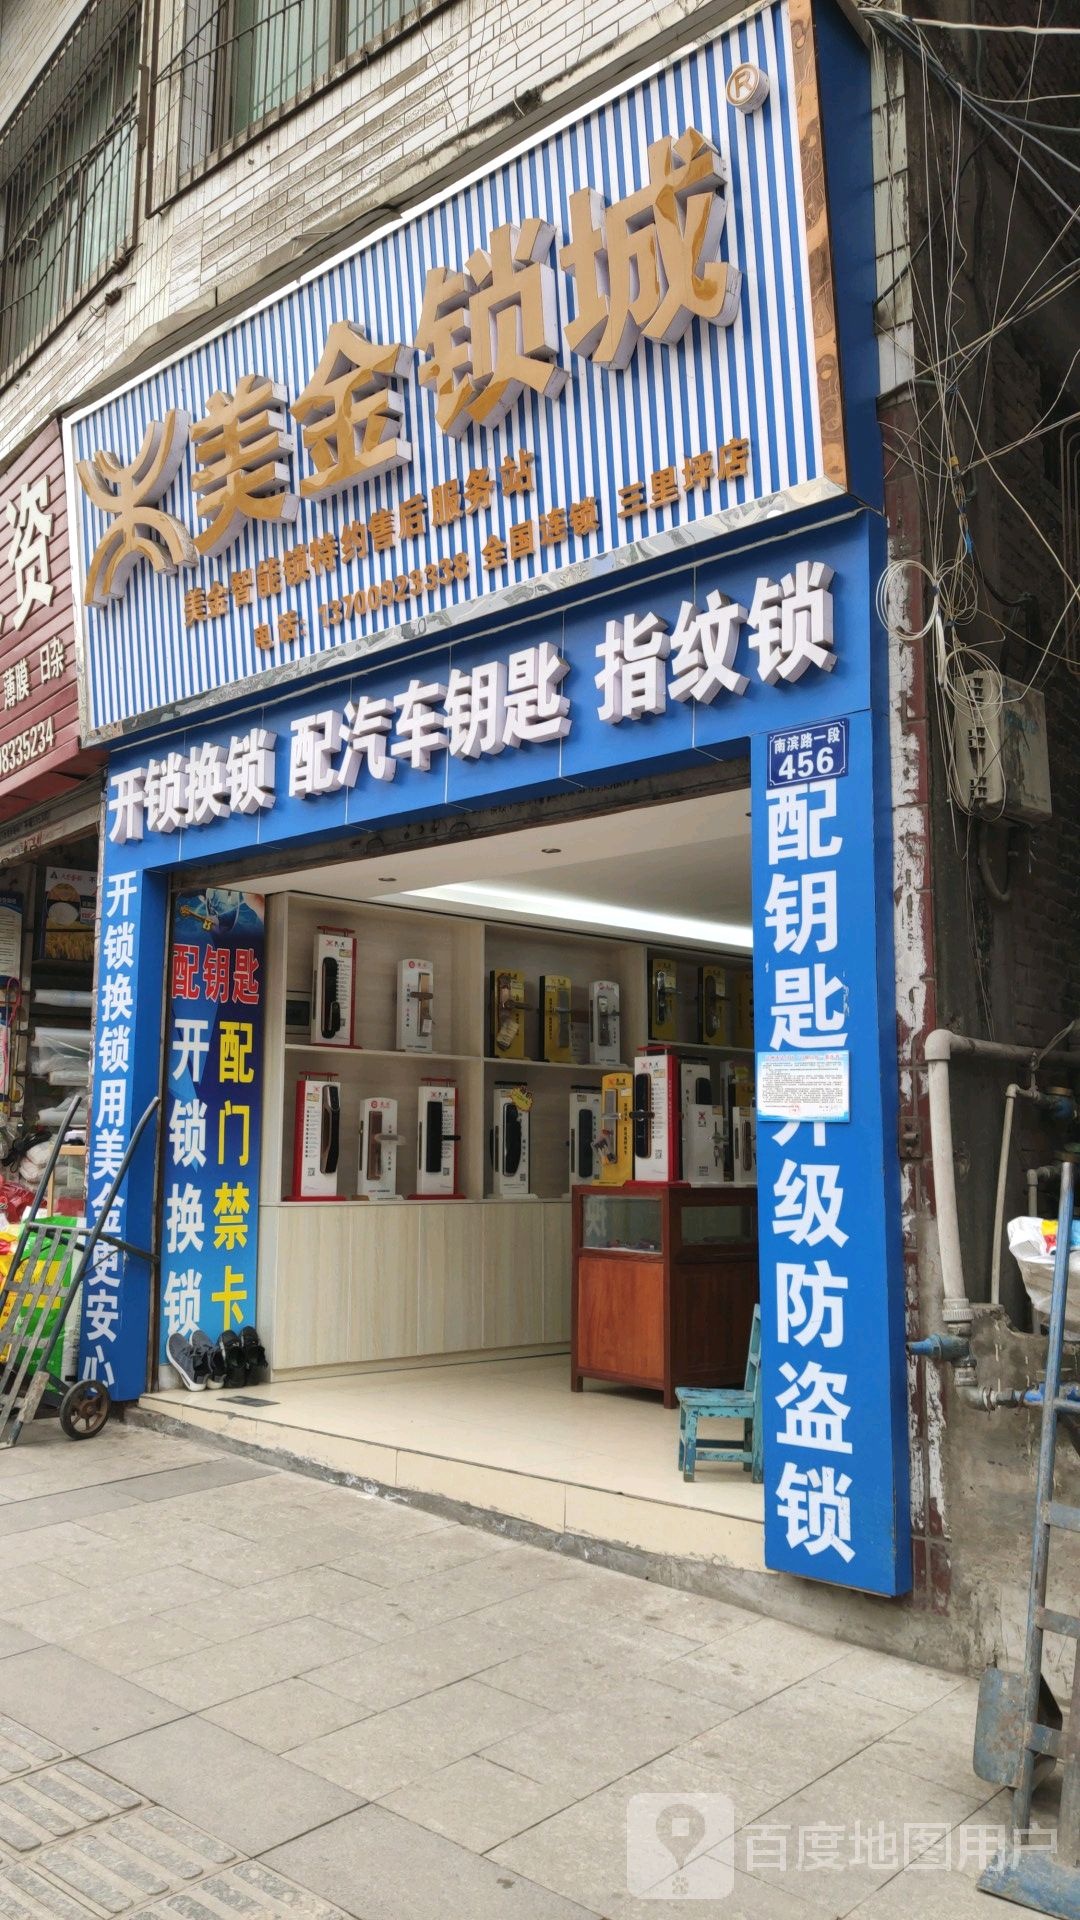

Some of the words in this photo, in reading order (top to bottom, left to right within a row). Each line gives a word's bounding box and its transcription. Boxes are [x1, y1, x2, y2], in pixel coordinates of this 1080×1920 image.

[191, 127, 741, 556] 美金锁城
[6, 474, 54, 631] 资
[184, 449, 534, 628] 美金智能锁特约售后服务站
[318, 552, 470, 628] 13700923338
[481, 496, 600, 571] 全国连锁
[617, 438, 750, 519] 三里坪店
[40, 636, 64, 684] 日杂
[107, 729, 276, 845] 开锁换锁
[289, 642, 569, 797] 配汽车钥匙
[596, 561, 841, 723] 指纹锁
[774, 727, 840, 754] 南滨路一段
[0, 716, 53, 774] 8335234
[779, 747, 834, 780] 456
[172, 943, 260, 1005] 配钥匙
[163, 1018, 210, 1338] 开锁换锁
[211, 1020, 255, 1331] 配门禁卡
